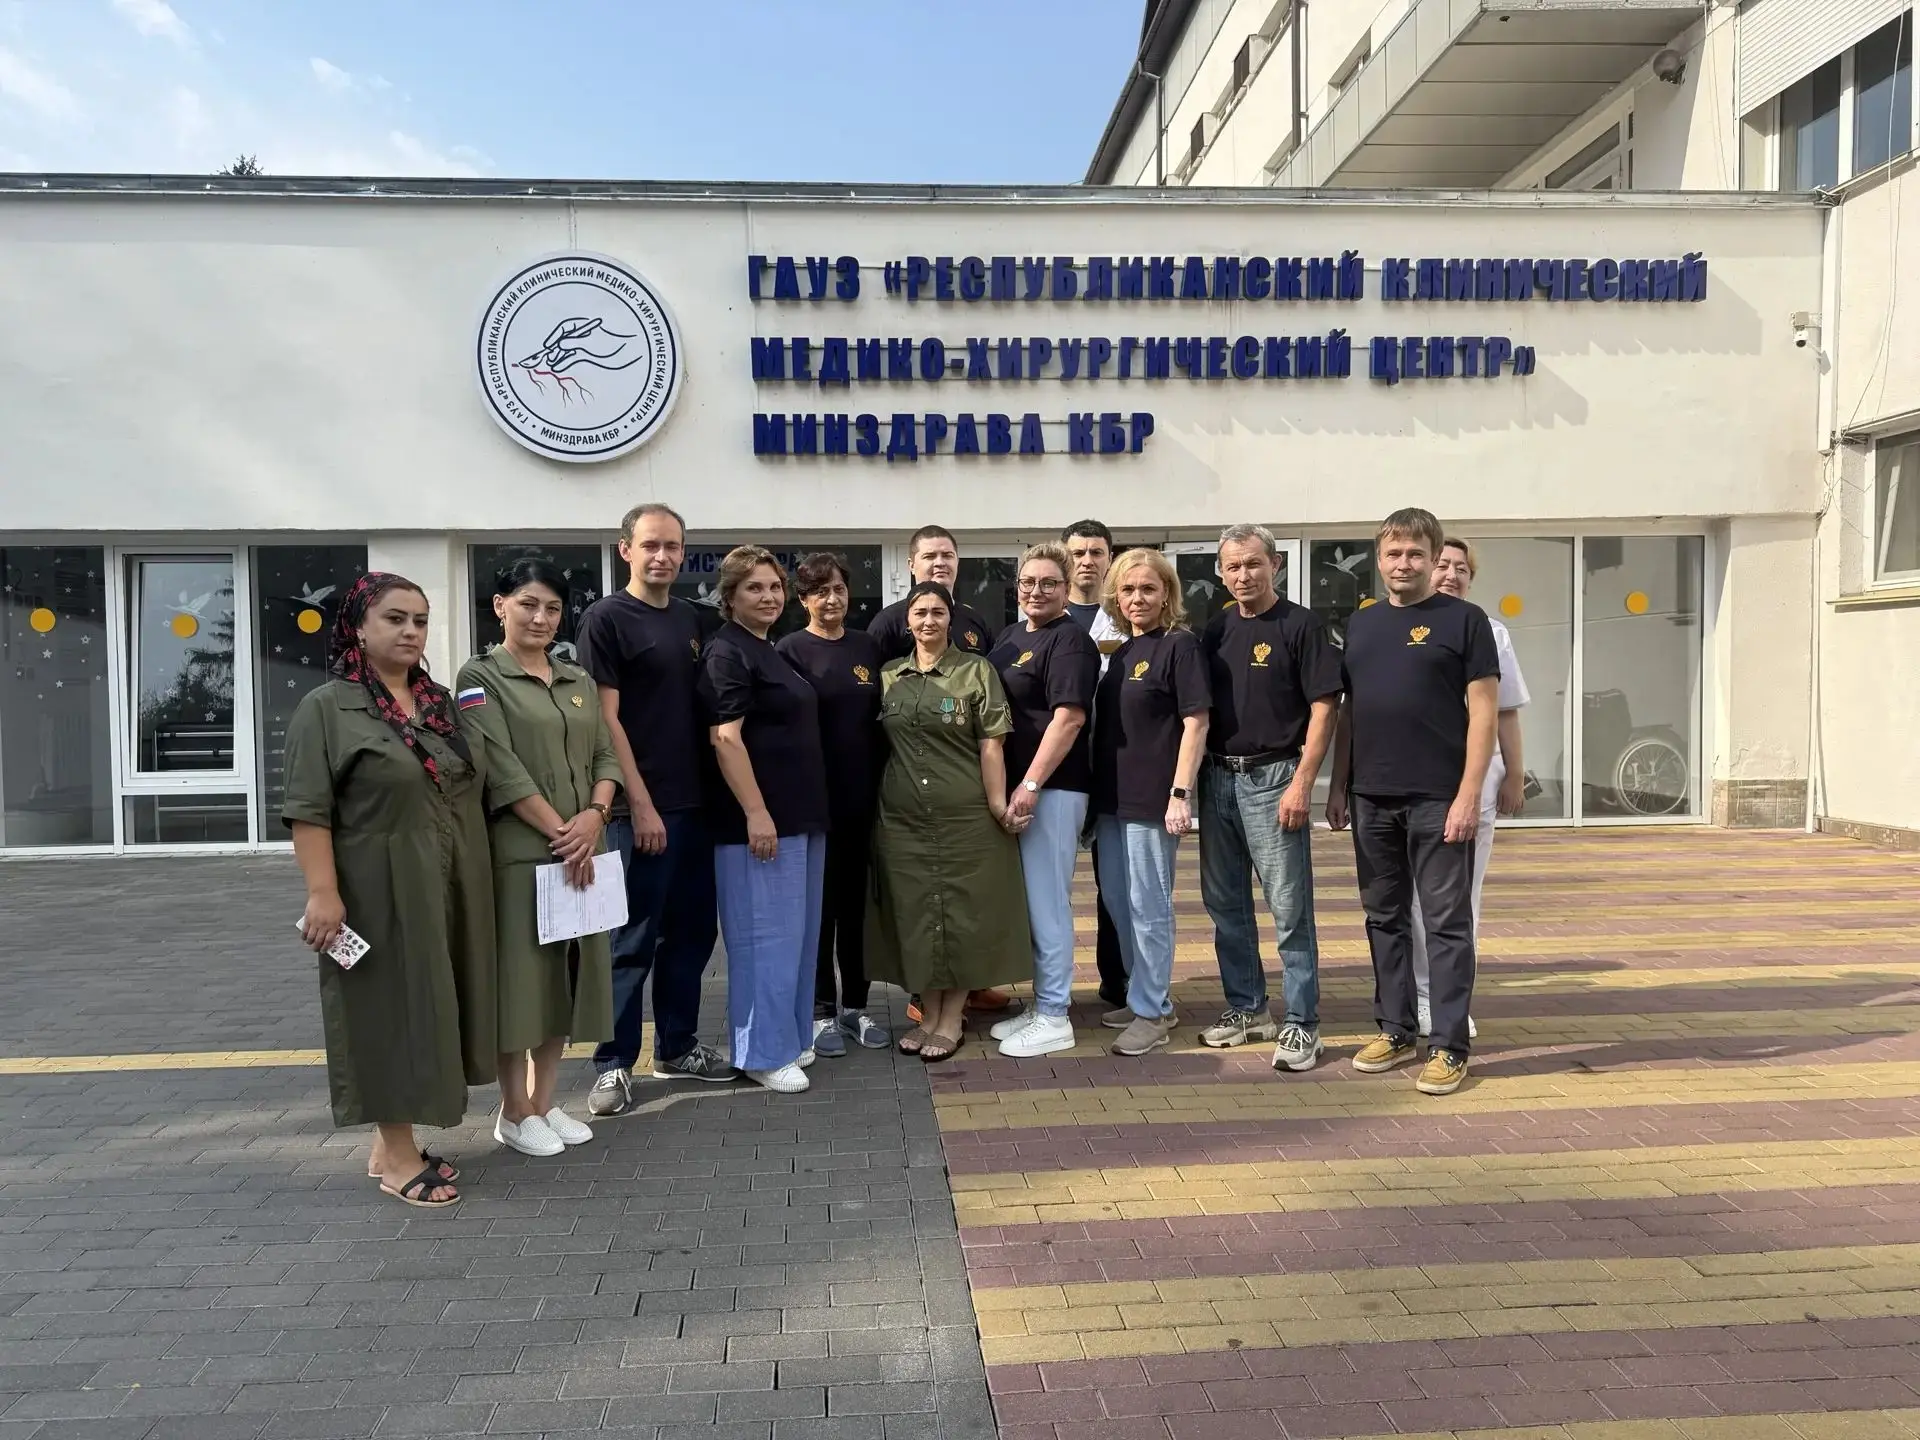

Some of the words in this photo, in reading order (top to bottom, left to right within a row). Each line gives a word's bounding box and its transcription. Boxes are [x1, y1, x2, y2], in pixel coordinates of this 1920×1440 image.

[516, 266, 595, 295] КЛИНИЧЕСКИЙ
[748, 255, 860, 300] ГАУЗ
[884, 250, 1364, 301] «РЕСПУБЛИКАНСКИЙ
[1381, 252, 1708, 302] КЛИНИЧЕСКИЙ
[487, 291, 521, 401] «РЕСПУБЛИКАНСКИЙ
[595, 271, 667, 390] МЕДИКО-ХИРУРГИЧЕСКИЙ
[751, 328, 1351, 387] МЕДИКО-ХИРУРГИЧЕСКИЙ
[1369, 335, 1536, 386] ЦЕНТР»
[506, 400, 529, 424] ГАУЗ
[540, 426, 602, 446] МИНЗДРАВА
[602, 428, 621, 442] КБР
[753, 412, 1046, 462] МИНЗДРАВА
[1068, 412, 1155, 455] КБР
